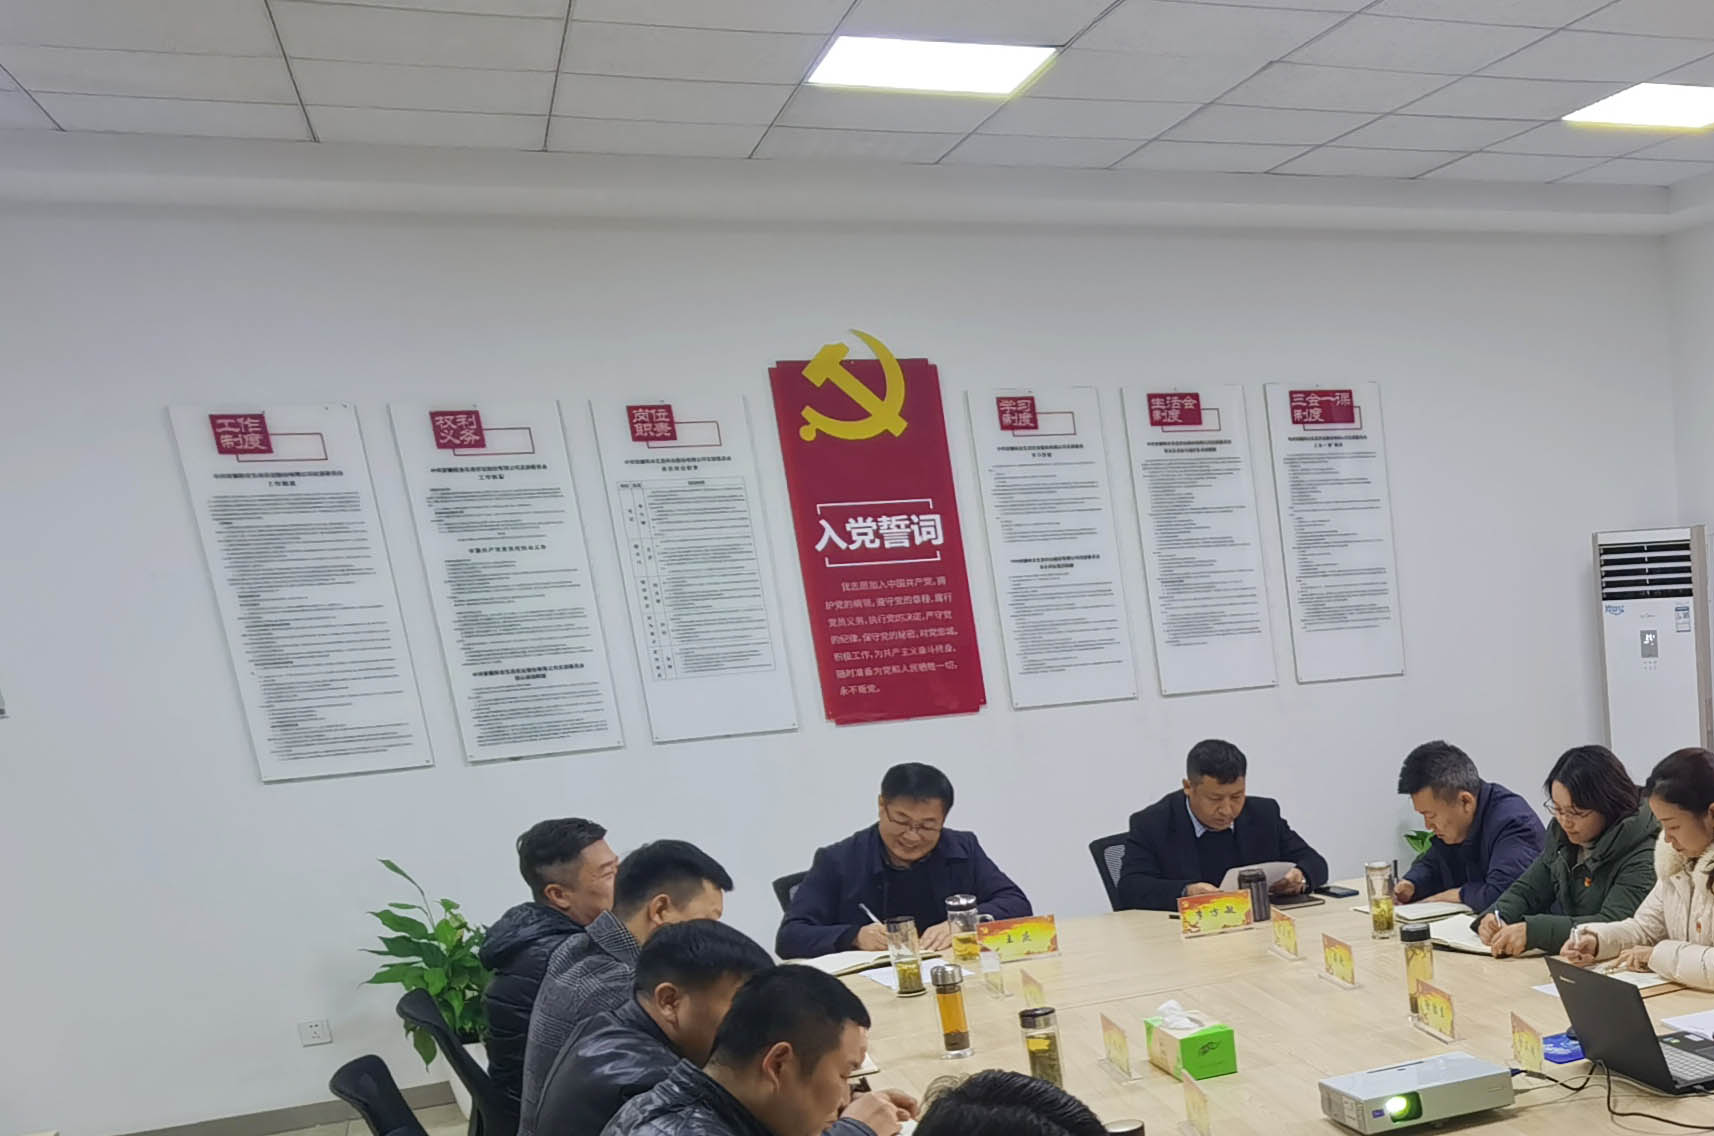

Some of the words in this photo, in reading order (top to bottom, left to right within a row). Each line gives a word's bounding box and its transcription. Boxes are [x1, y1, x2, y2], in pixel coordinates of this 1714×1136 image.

[1000, 399, 1032, 413] 学习
[1151, 395, 1198, 409] 生活会
[1291, 392, 1351, 407] 三会一课
[435, 414, 478, 429] 权利
[632, 408, 670, 423] 岗位
[1002, 411, 1036, 427] 制度
[1152, 409, 1183, 423] 制度
[1293, 407, 1325, 422] 制度
[216, 417, 262, 433] 工作
[634, 422, 673, 437] 职责
[220, 433, 268, 450] 制度
[440, 429, 481, 445] 义务
[815, 514, 944, 552] 入党誓词
